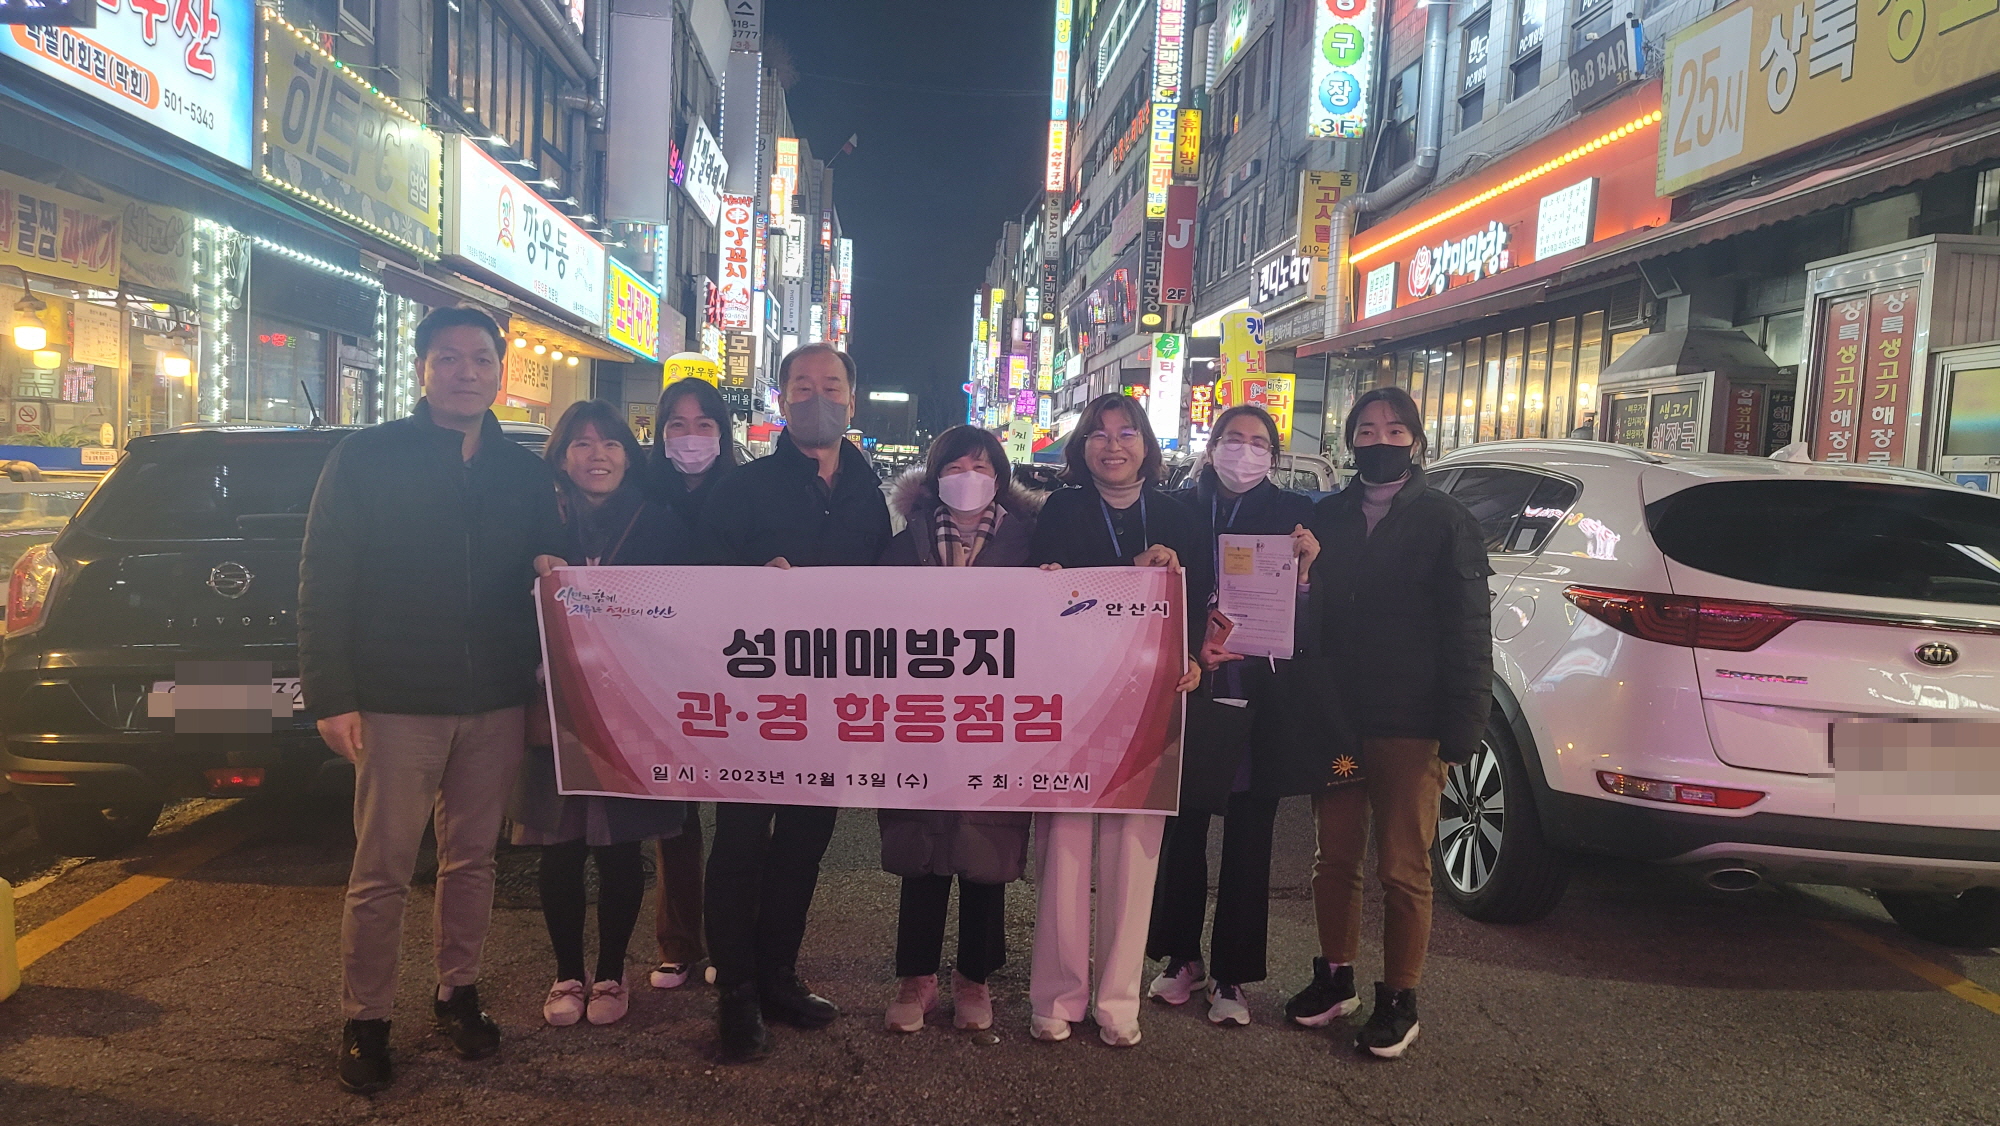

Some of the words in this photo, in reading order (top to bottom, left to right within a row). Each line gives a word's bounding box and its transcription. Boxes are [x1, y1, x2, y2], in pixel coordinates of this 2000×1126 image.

[1053, 49, 1069, 102] 안마
[1570, 58, 1595, 97] B&B
[1596, 38, 1628, 81] BAR
[1616, 68, 1628, 85] 3F
[163, 88, 215, 131] 501-5343
[1673, 46, 1745, 157] 25시
[1319, 117, 1356, 134] 3F
[1179, 118, 1198, 166] 휴계방
[17, 193, 59, 262] 굴찜
[60, 207, 118, 276] 과메기
[522, 203, 569, 280] 깡우동
[1167, 219, 1193, 249] J
[724, 227, 749, 279] 양꼬치
[1301, 245, 1329, 255] 419-
[1166, 288, 1187, 300] 2F
[728, 334, 750, 375] 모텔
[684, 365, 715, 378] 깡우동
[731, 377, 744, 386] 5F
[1659, 397, 1694, 420] 생고기
[1651, 420, 1697, 452] 해장국
[646, 605, 678, 619] 안산
[1104, 602, 1169, 617] 안산시
[722, 627, 1016, 679] 성매매방지
[1923, 647, 1954, 662] KIA
[1714, 668, 1808, 685] SPORTAGE
[676, 690, 809, 742] 관·경
[833, 692, 1064, 744] 합동점검
[718, 768, 786, 785] 2023년
[795, 771, 836, 788] 12월
[845, 772, 887, 788] 13일
[896, 772, 929, 790] (수)
[1031, 774, 1090, 791] 안산시
